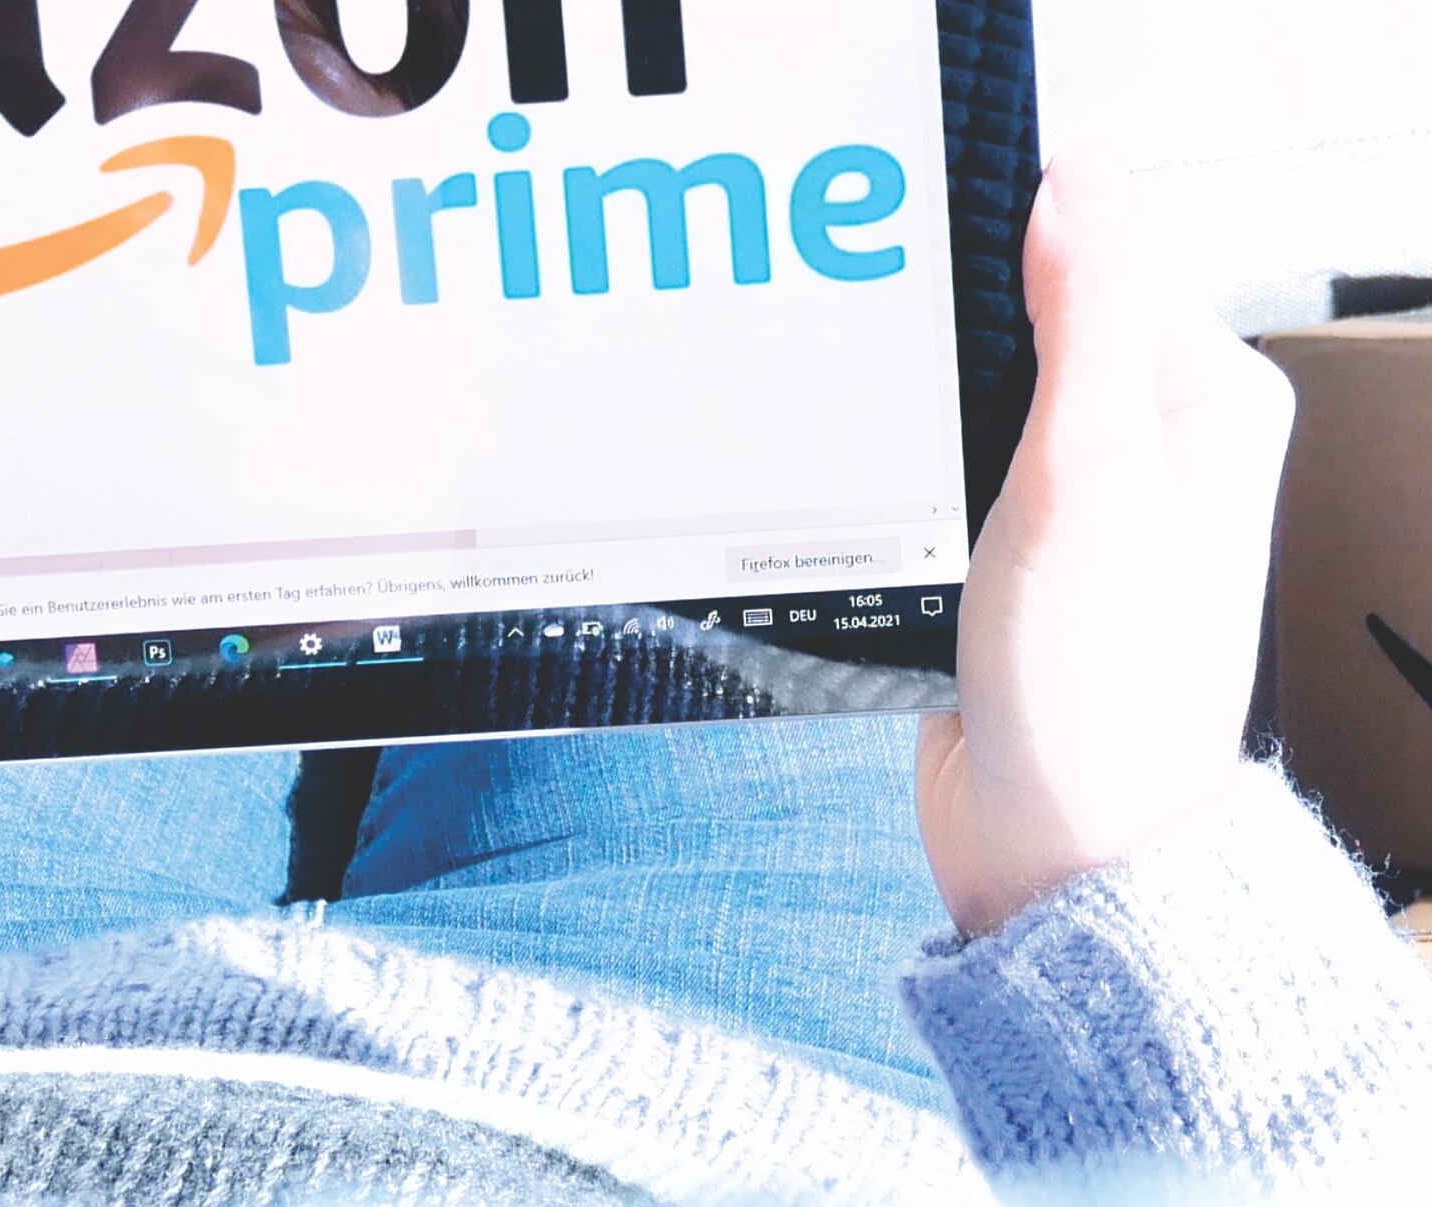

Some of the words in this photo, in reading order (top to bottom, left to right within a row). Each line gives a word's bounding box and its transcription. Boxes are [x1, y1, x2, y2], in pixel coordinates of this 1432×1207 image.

[241, 111, 906, 367] prime
[741, 553, 790, 573] Firefox
[21, 602, 43, 615] ein
[48, 594, 168, 613] Benutzererlebnis
[172, 592, 196, 605] wie
[200, 593, 223, 604] am
[227, 589, 271, 603] ersten
[276, 586, 301, 602] Tag
[305, 581, 373, 598] erfahren?
[377, 577, 446, 595] Übrigens,
[450, 573, 538, 590] willkommen
[543, 568, 595, 585] zurück!
[848, 594, 883, 608] 16:05
[788, 609, 817, 623] DEU
[833, 614, 902, 630] 15.04.2021
[149, 645, 166, 660] Ps
